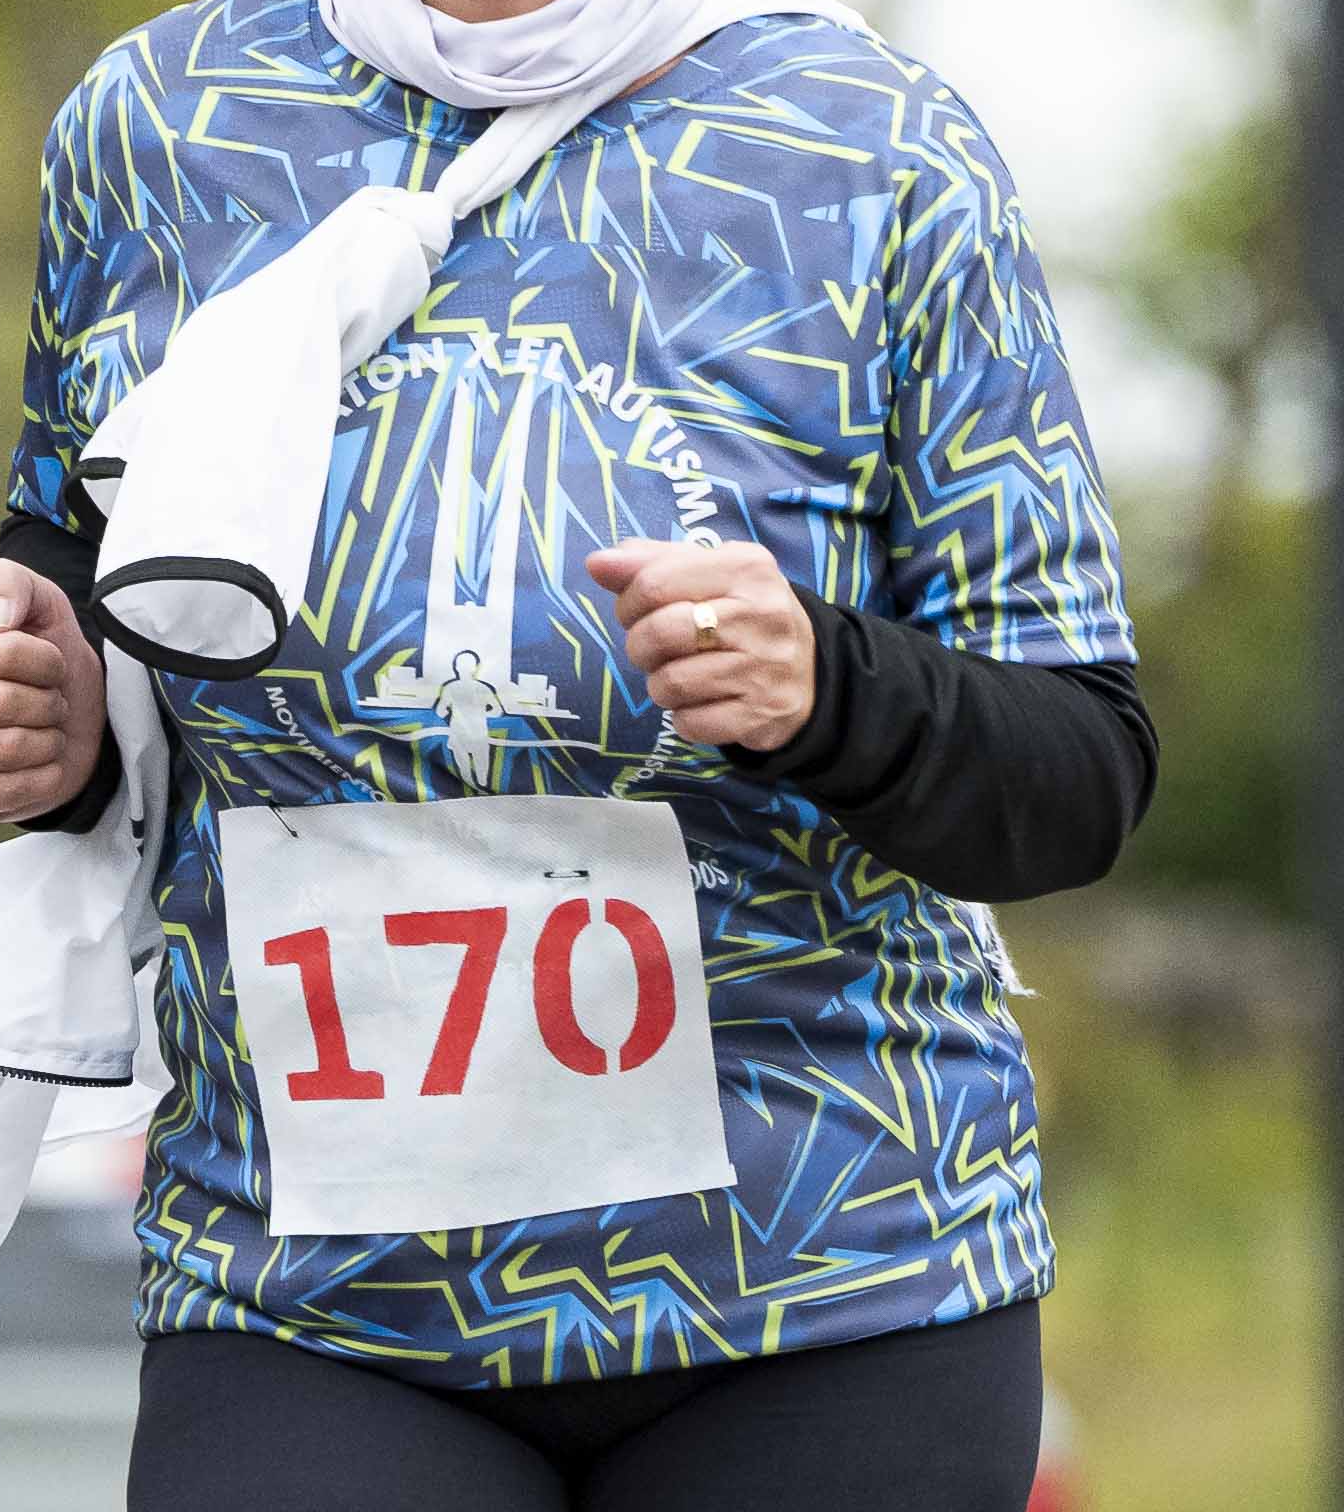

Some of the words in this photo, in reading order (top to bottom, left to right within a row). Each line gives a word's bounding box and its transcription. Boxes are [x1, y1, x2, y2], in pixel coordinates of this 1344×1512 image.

[463, 332, 501, 372] X
[516, 336, 565, 383] EL
[574, 361, 724, 549] AUTISMO
[263, 897, 677, 1101] 170
